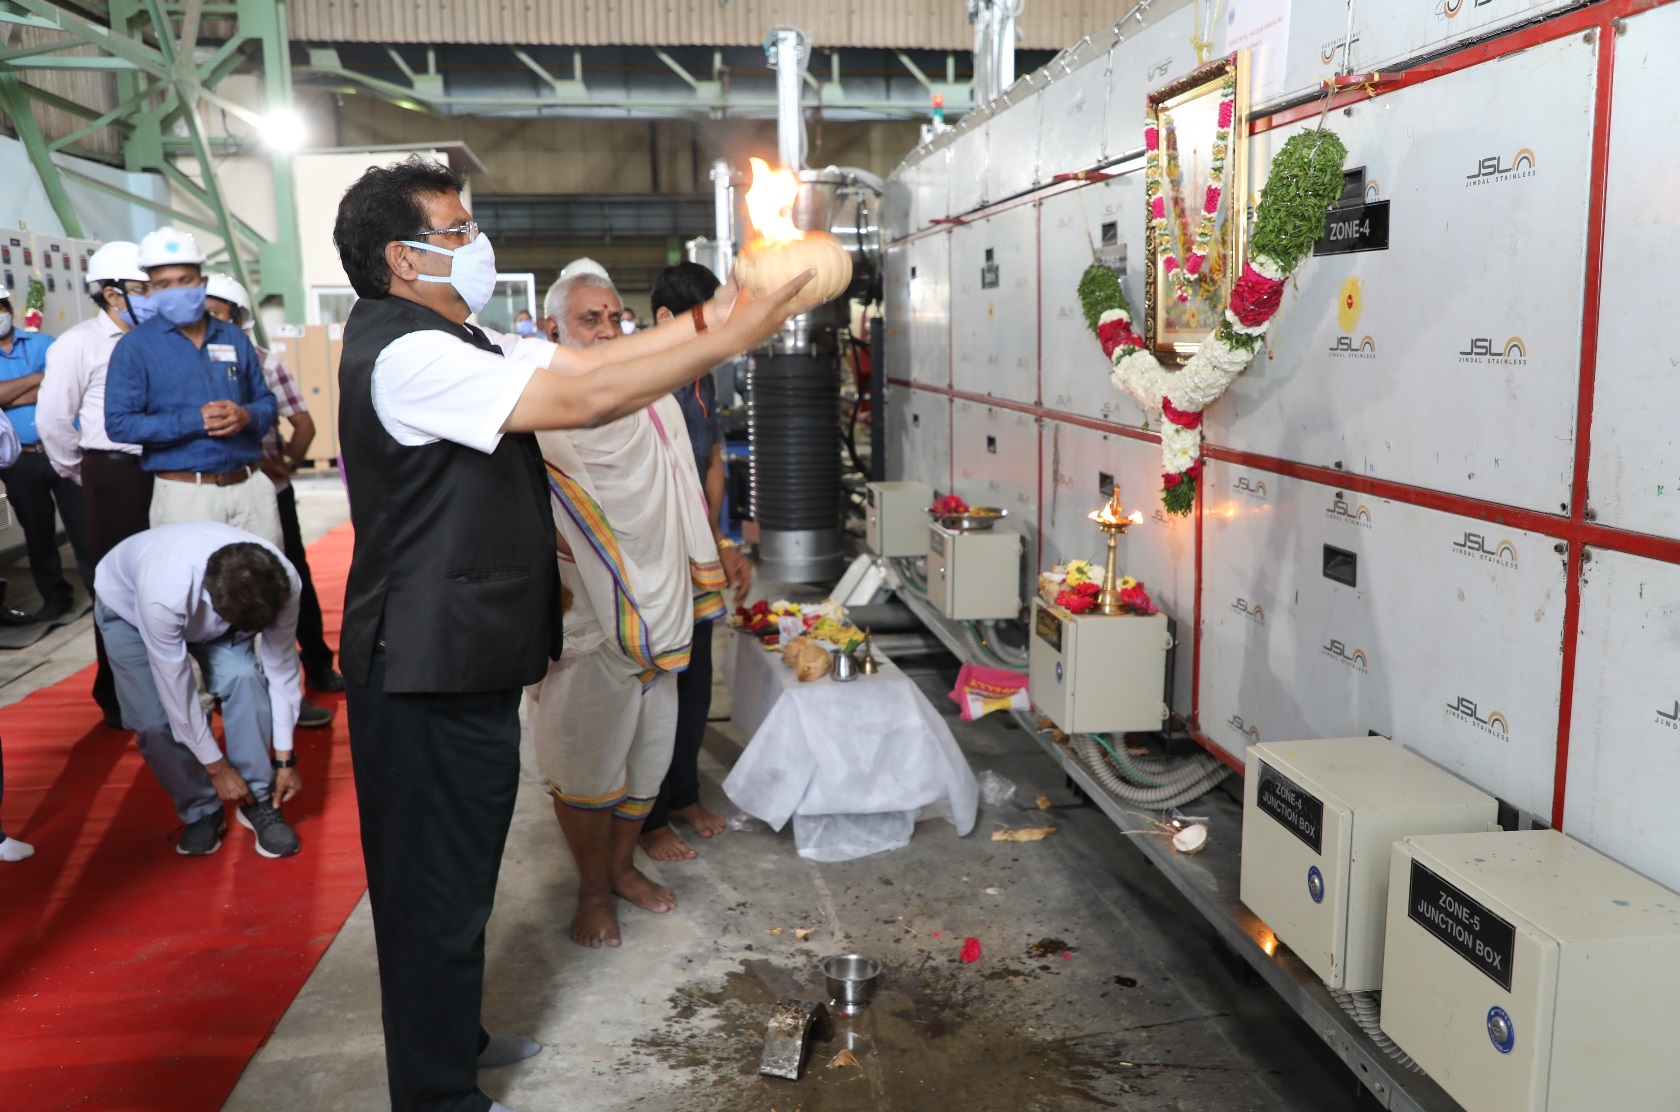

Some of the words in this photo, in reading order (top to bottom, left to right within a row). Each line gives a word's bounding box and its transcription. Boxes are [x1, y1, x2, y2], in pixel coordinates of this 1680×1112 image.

[1465, 178, 1490, 187] JINDAL
[1495, 169, 1536, 183] STAINLESS
[1466, 155, 1513, 179] JSL
[1329, 218, 1371, 241] ZONE-4
[1328, 336, 1360, 352] JSL
[1459, 338, 1504, 357] JSL
[1487, 358, 1527, 366] STAINLESS
[1325, 499, 1356, 519] JSL
[1453, 531, 1496, 556] JSL
[1452, 547, 1475, 558] JINDAL
[1480, 554, 1519, 570] STAINLESS
[1322, 638, 1353, 661] JSL
[1446, 695, 1488, 725] JSL
[1445, 708, 1468, 723] JINDAL
[1472, 720, 1510, 743] STAINLESS
[1654, 716, 1680, 730] JIND
[1276, 783, 1303, 811] ZONE-4
[1262, 791, 1298, 826] JUNCTION
[1299, 816, 1316, 839] BOX
[1438, 890, 1481, 931] ZONE-5
[1417, 899, 1473, 949] JUNCTION
[1475, 939, 1502, 971] BOX
